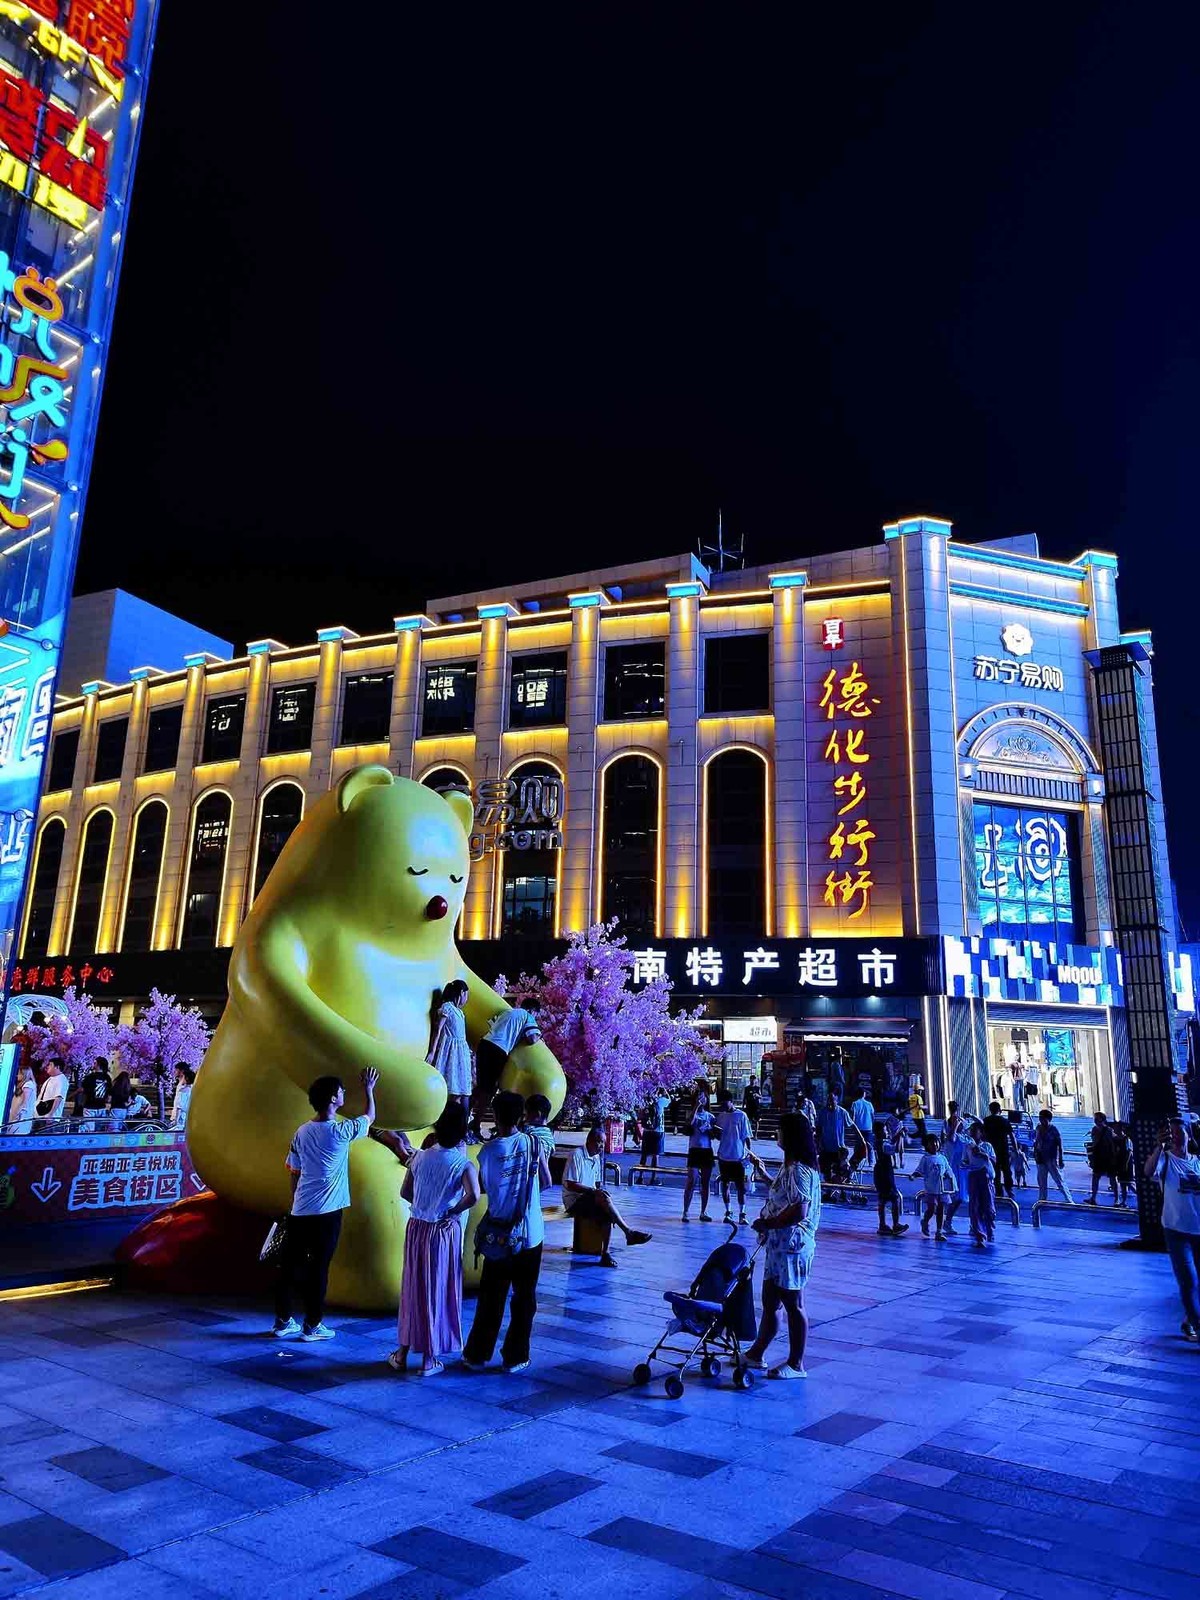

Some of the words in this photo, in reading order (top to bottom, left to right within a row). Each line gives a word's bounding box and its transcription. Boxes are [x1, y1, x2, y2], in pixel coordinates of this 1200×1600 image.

[974, 655, 1064, 692] 苏宁易购
[819, 662, 881, 919] 德化步行街
[633, 947, 897, 988] 南特产超市
[82, 1155, 178, 1174] 亚细亚卓悦城
[72, 1174, 179, 1206] 美食街区
